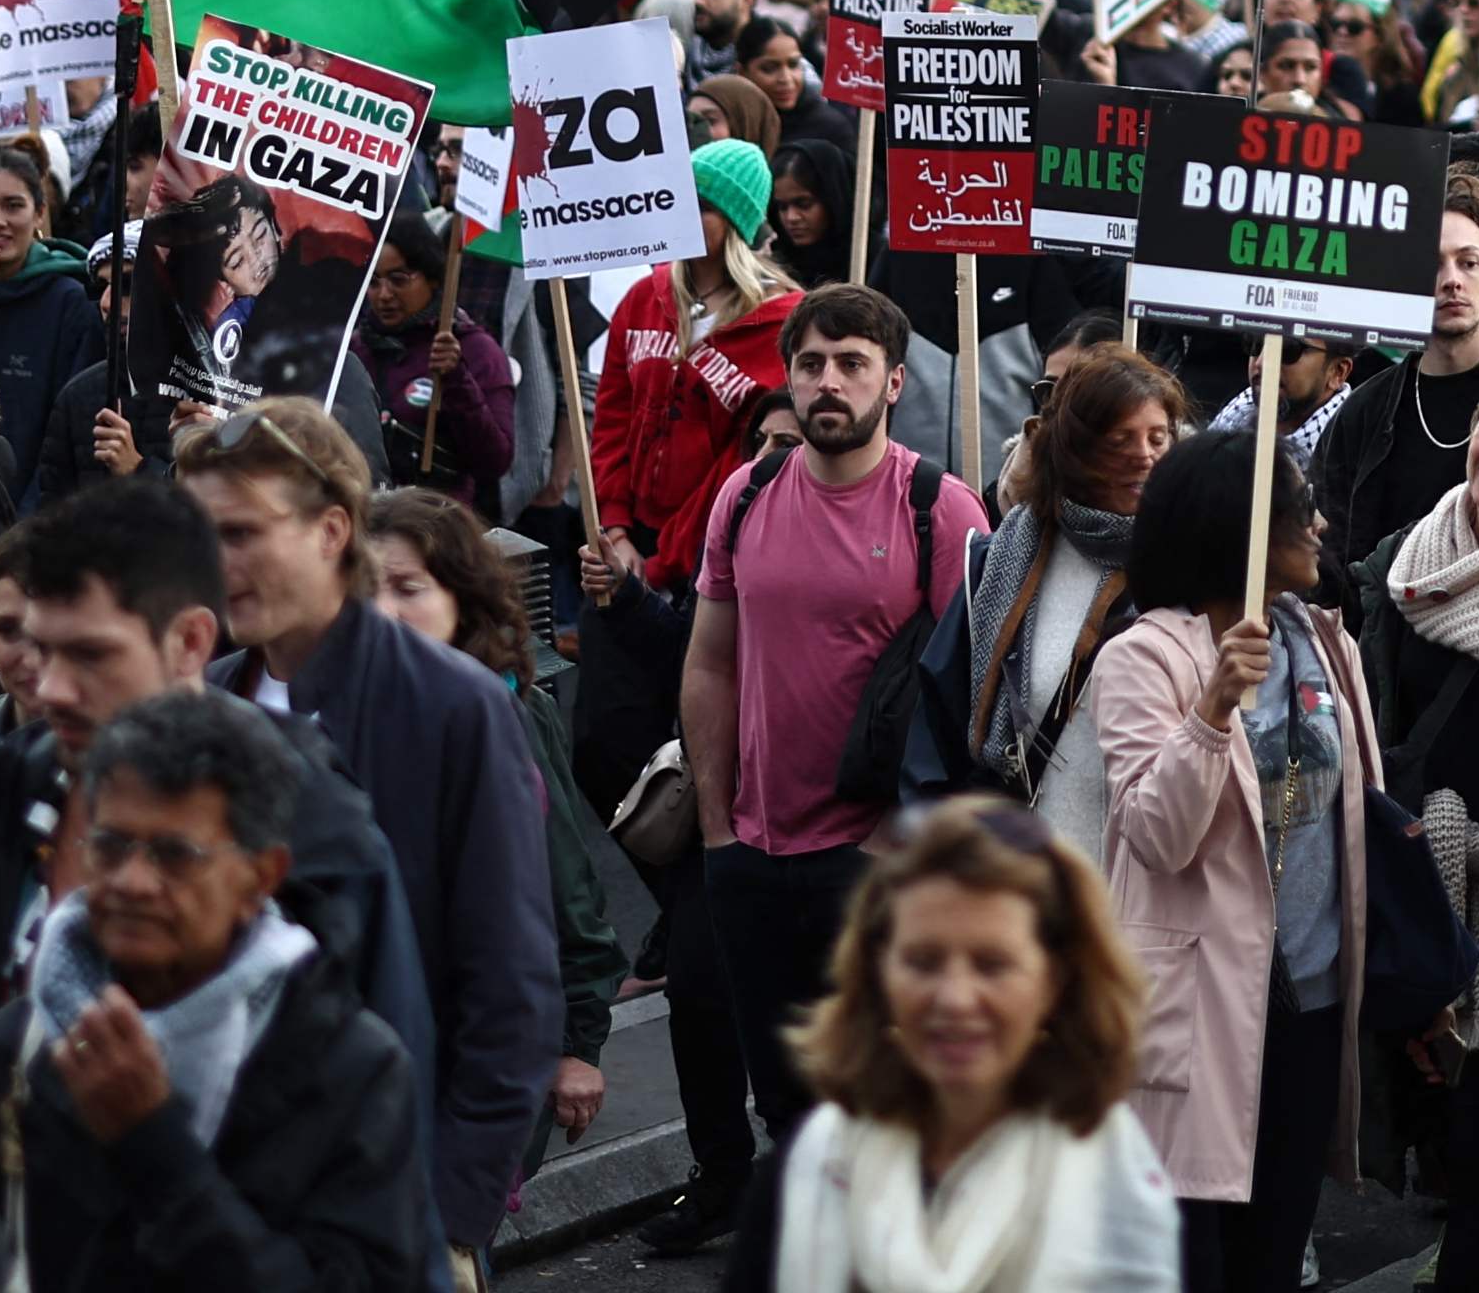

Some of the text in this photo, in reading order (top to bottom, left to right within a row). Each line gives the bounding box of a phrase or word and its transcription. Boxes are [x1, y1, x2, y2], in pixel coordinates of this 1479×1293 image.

[20, 20, 116, 47] massac
[897, 47, 1021, 86] FREEDOM
[208, 46, 408, 134] STOP KILLING
[949, 87, 971, 104] for
[196, 78, 404, 168] THE CHILDREN
[540, 86, 664, 170] za
[893, 104, 1031, 143] PALESTINE
[1096, 104, 1151, 147] FR
[1239, 114, 1364, 172] STOP
[184, 114, 380, 212] IN GAZA
[917, 159, 1008, 195] الحرية
[1041, 145, 1146, 194] PALES
[533, 188, 675, 229] massacre
[909, 199, 1023, 232] لفلسطين
[1182, 161, 1410, 232] BOMBING
[1107, 222, 1127, 241] FOA
[1229, 219, 1349, 276] GAZA
[552, 241, 668, 266] www.stopwar.org.uk
[1246, 283, 1319, 308] FOA FRIENDS
